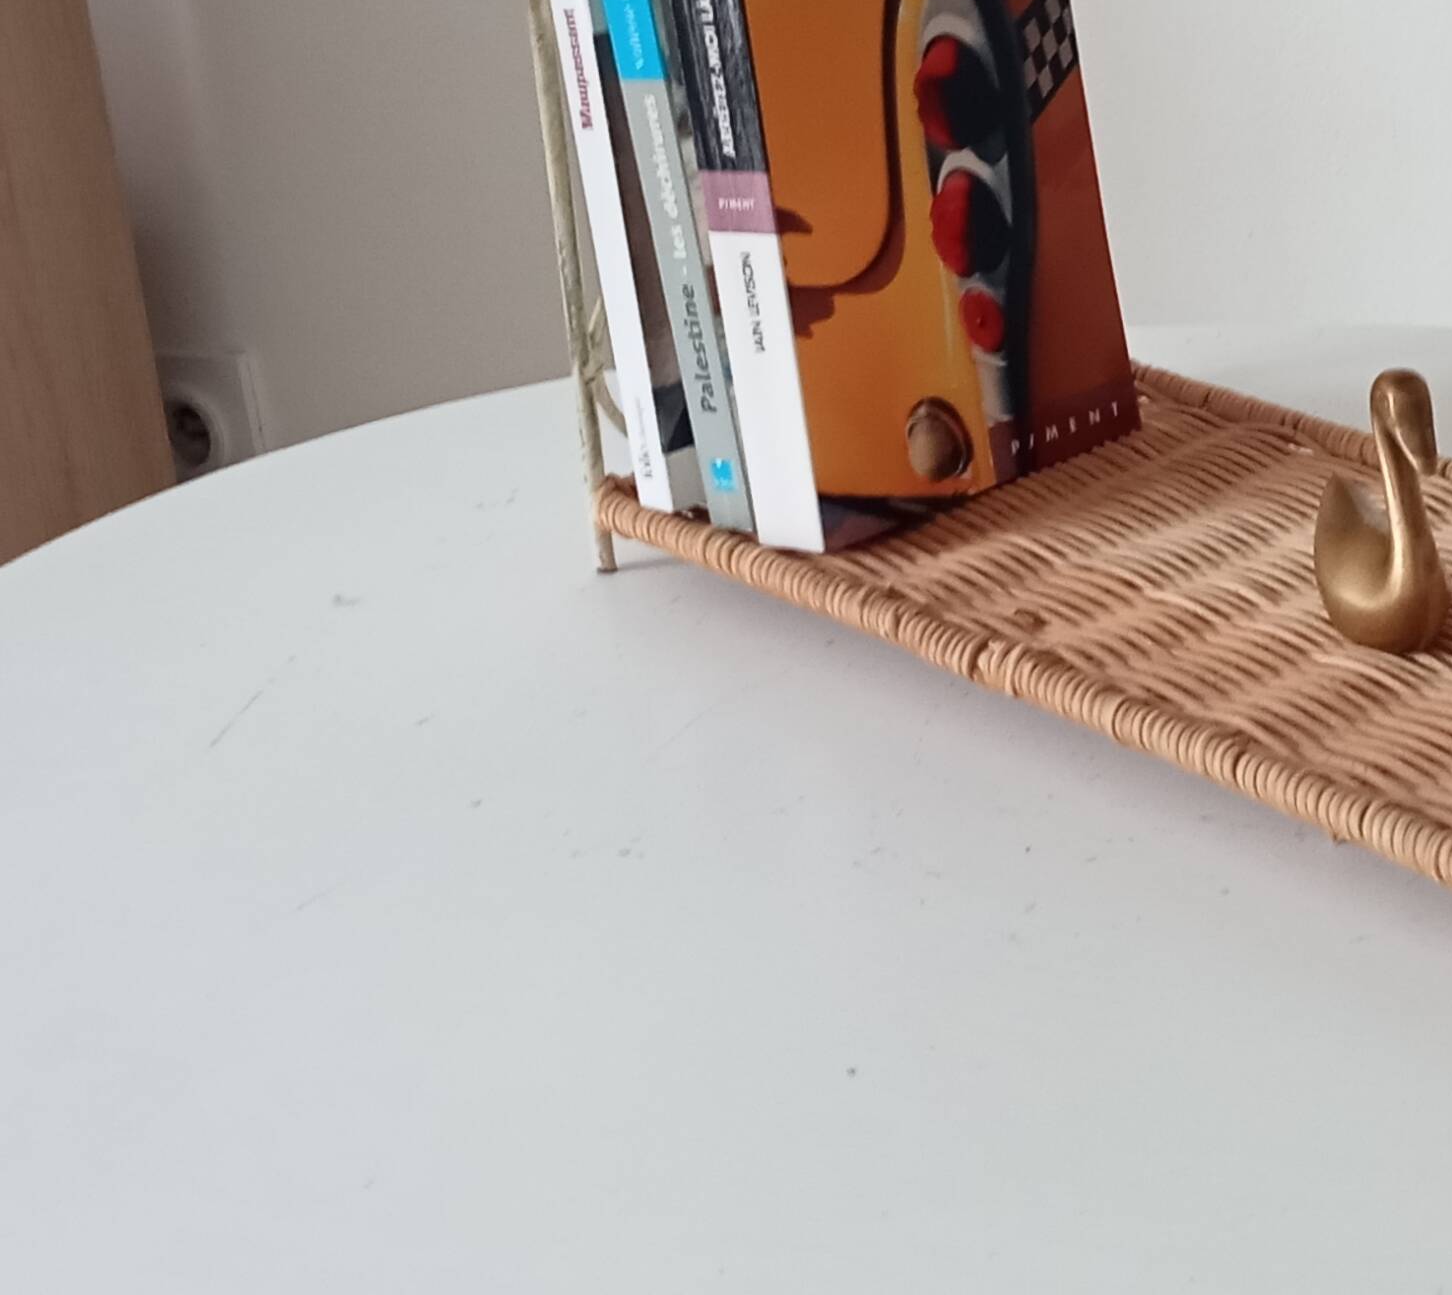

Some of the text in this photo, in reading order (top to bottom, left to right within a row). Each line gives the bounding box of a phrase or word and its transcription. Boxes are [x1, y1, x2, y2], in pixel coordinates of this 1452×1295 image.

[564, 8, 594, 130] Maupassant
[718, 197, 754, 211] PIMENT
[671, 225, 687, 259] les
[742, 251, 761, 317] LEVISON
[682, 284, 718, 413] Palestine
[1010, 401, 1119, 456] PIMENT
